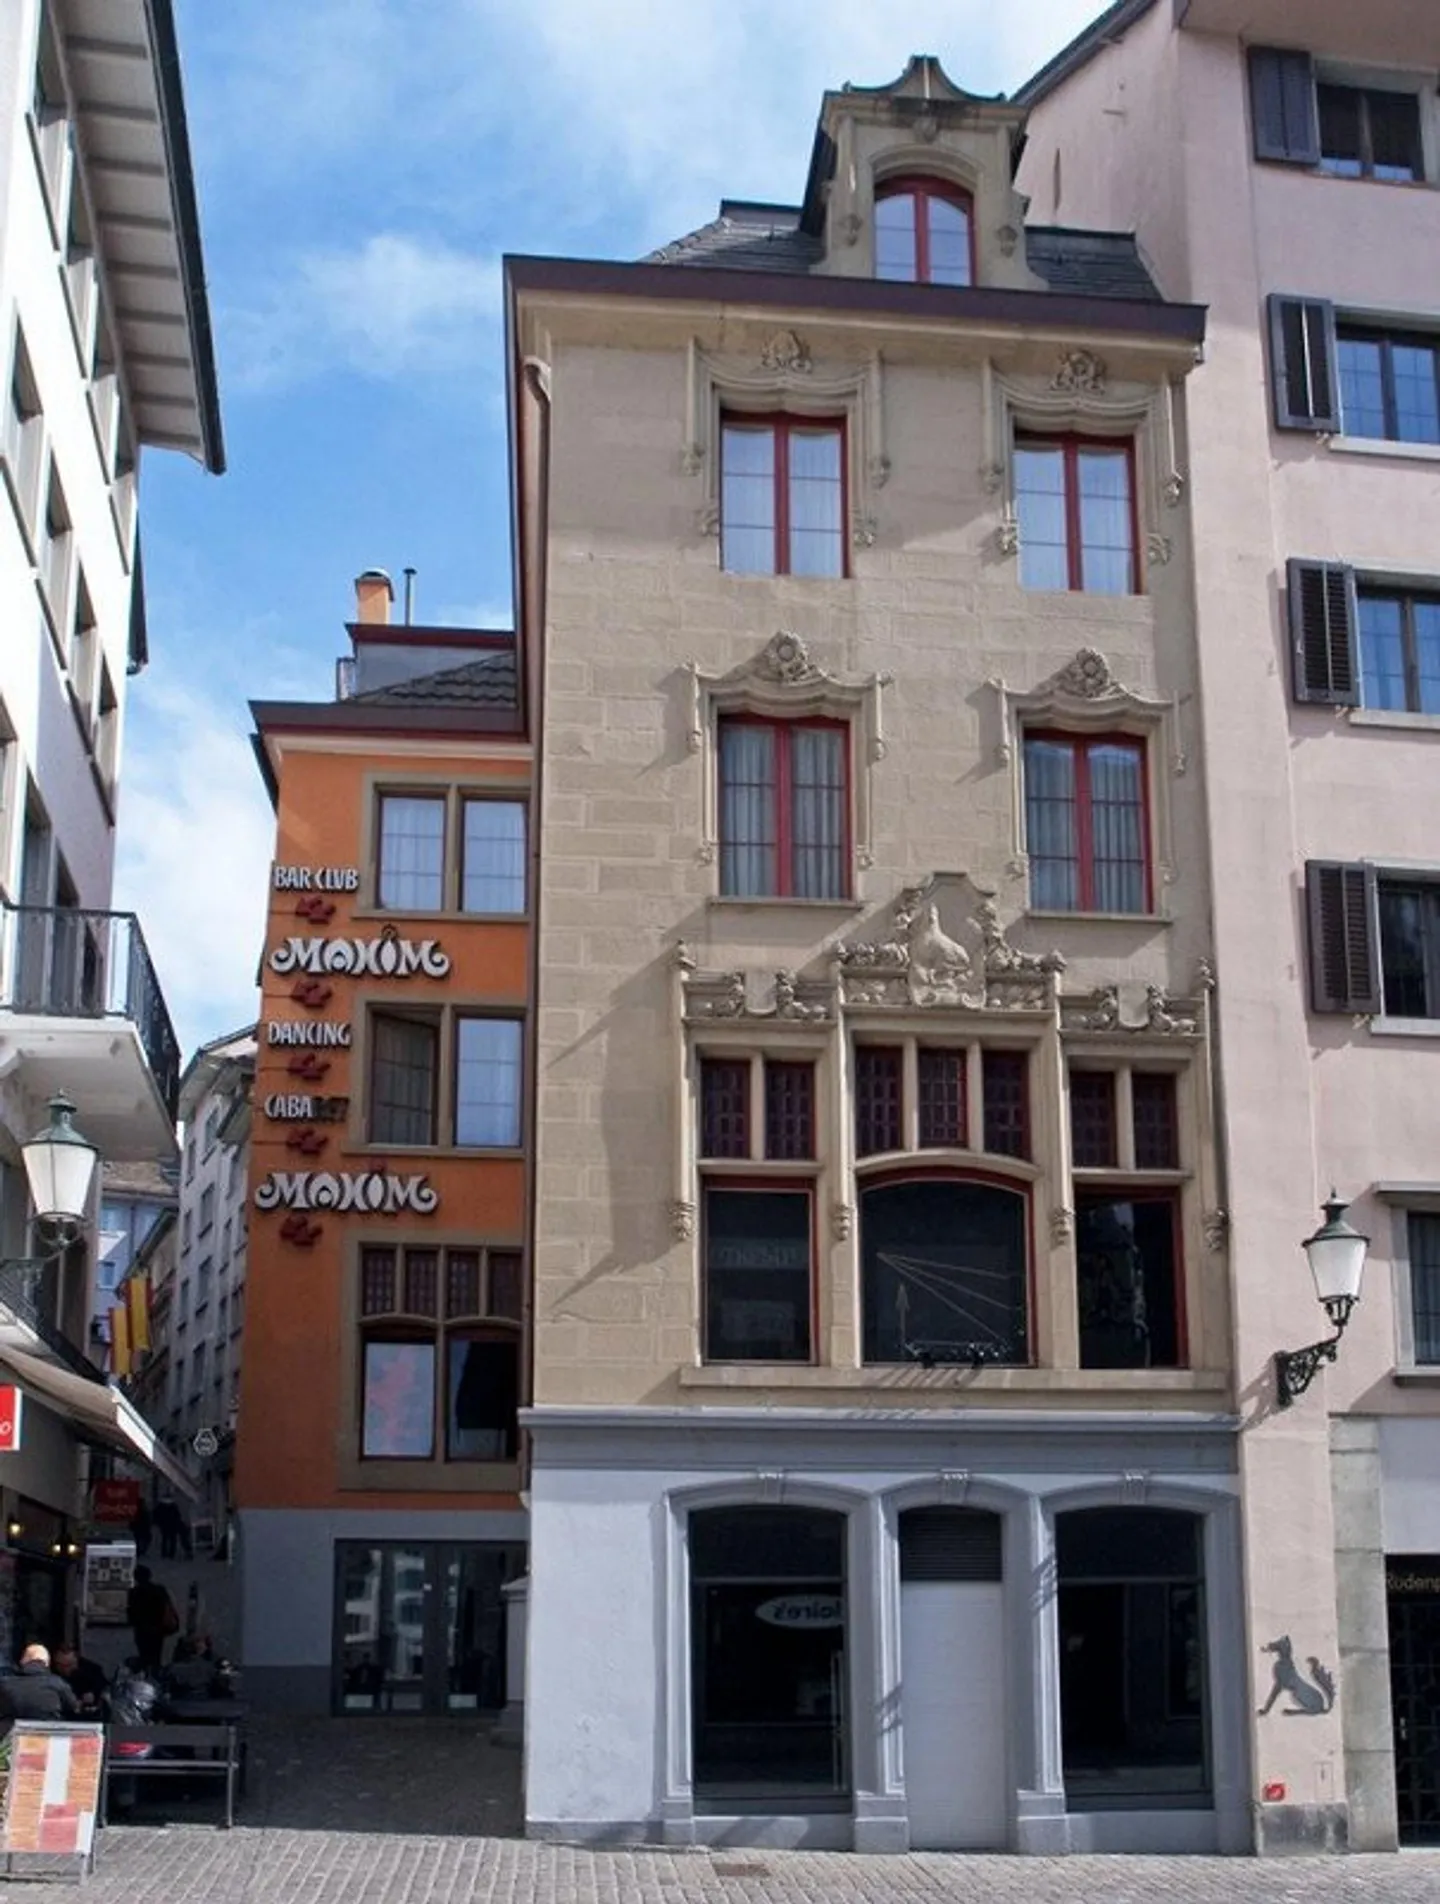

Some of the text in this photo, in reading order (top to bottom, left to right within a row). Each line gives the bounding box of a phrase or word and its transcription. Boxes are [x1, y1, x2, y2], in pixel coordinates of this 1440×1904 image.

[274, 866, 359, 891] BAR CLUB
[269, 936, 451, 977] MAXIM
[267, 1021, 350, 1046] DANCING
[254, 1171, 438, 1214] MAXIM
